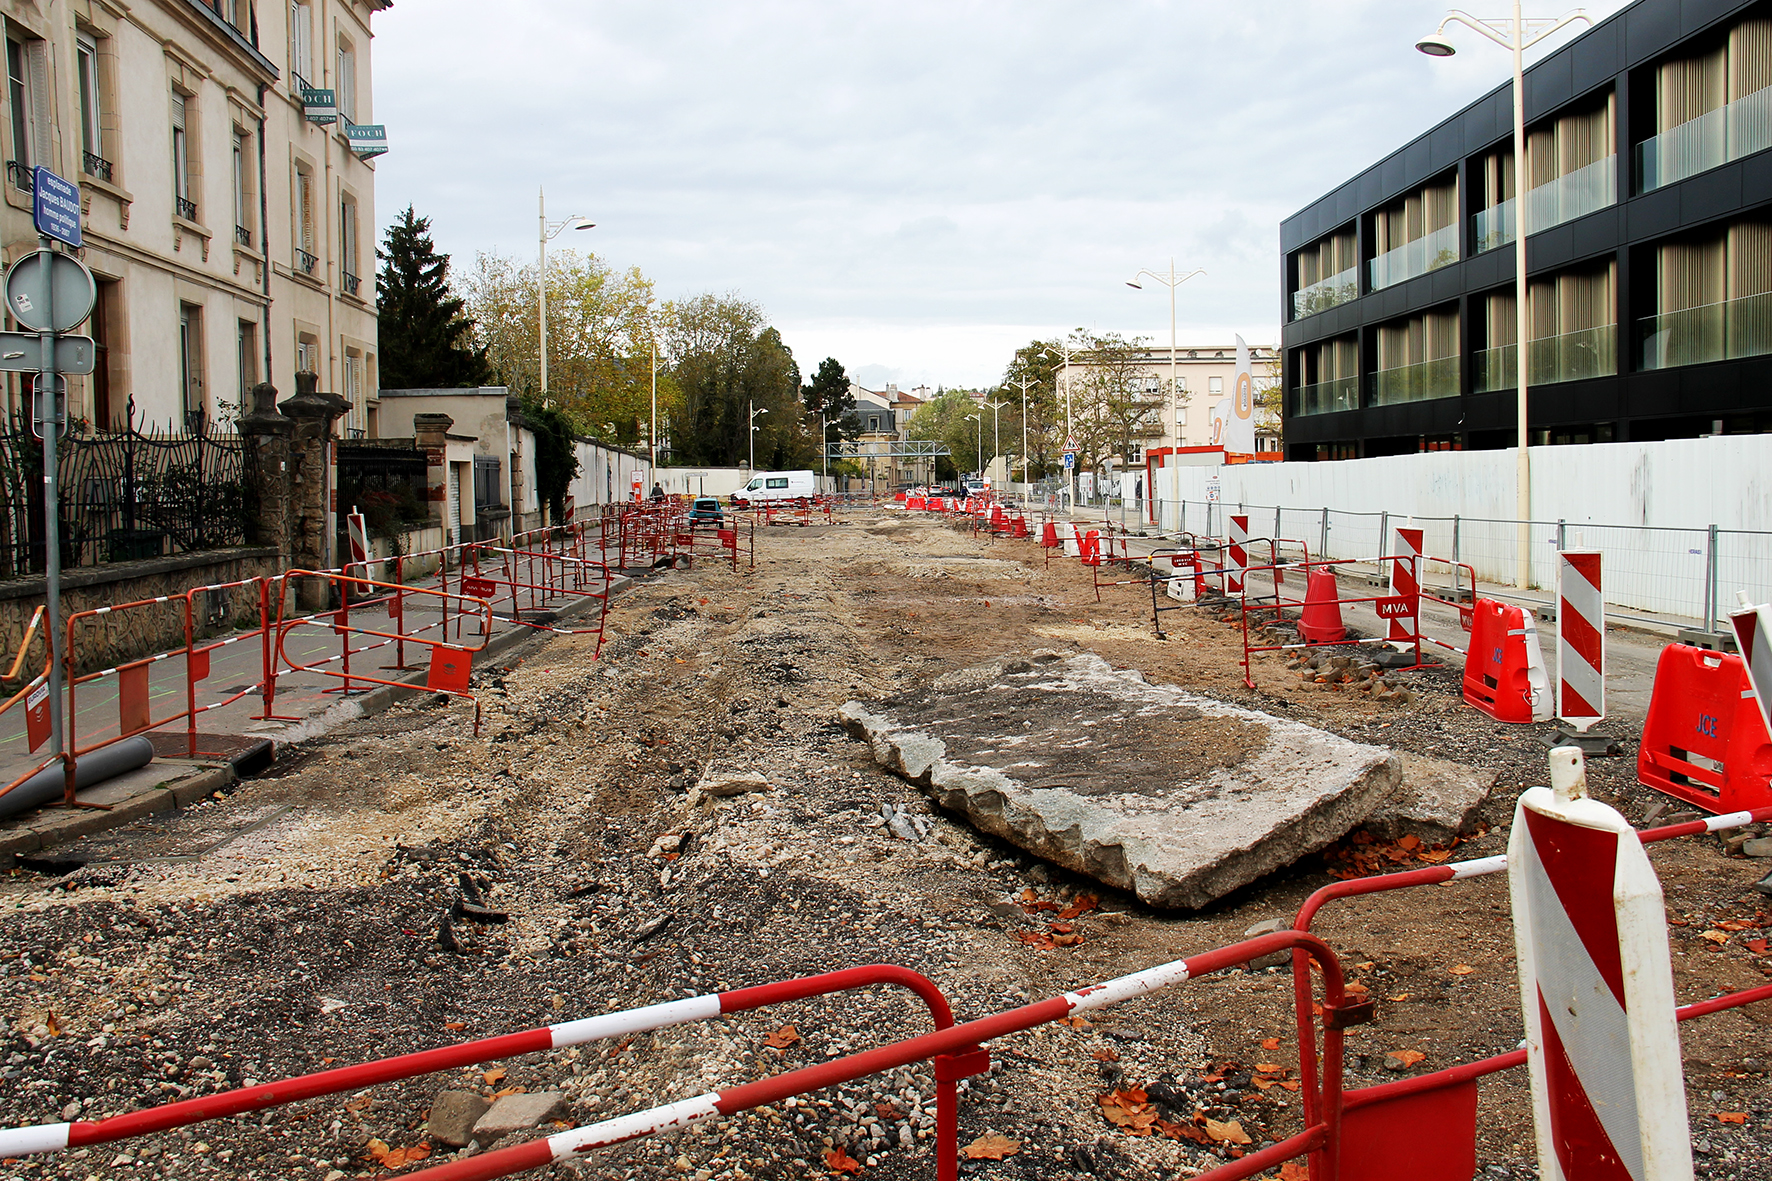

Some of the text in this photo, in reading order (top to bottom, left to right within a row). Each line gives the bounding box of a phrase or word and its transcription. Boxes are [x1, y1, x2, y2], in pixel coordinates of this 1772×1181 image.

[304, 95, 331, 103] OCH
[46, 176, 72, 196] esplanade
[38, 185, 80, 216] Jacques BAUDOT
[43, 204, 77, 230] homme politique
[61, 227, 70, 237] 2007
[1382, 602, 1409, 615] MVA
[28, 686, 46, 704] EUROVIA
[1694, 712, 1718, 739] JCE
